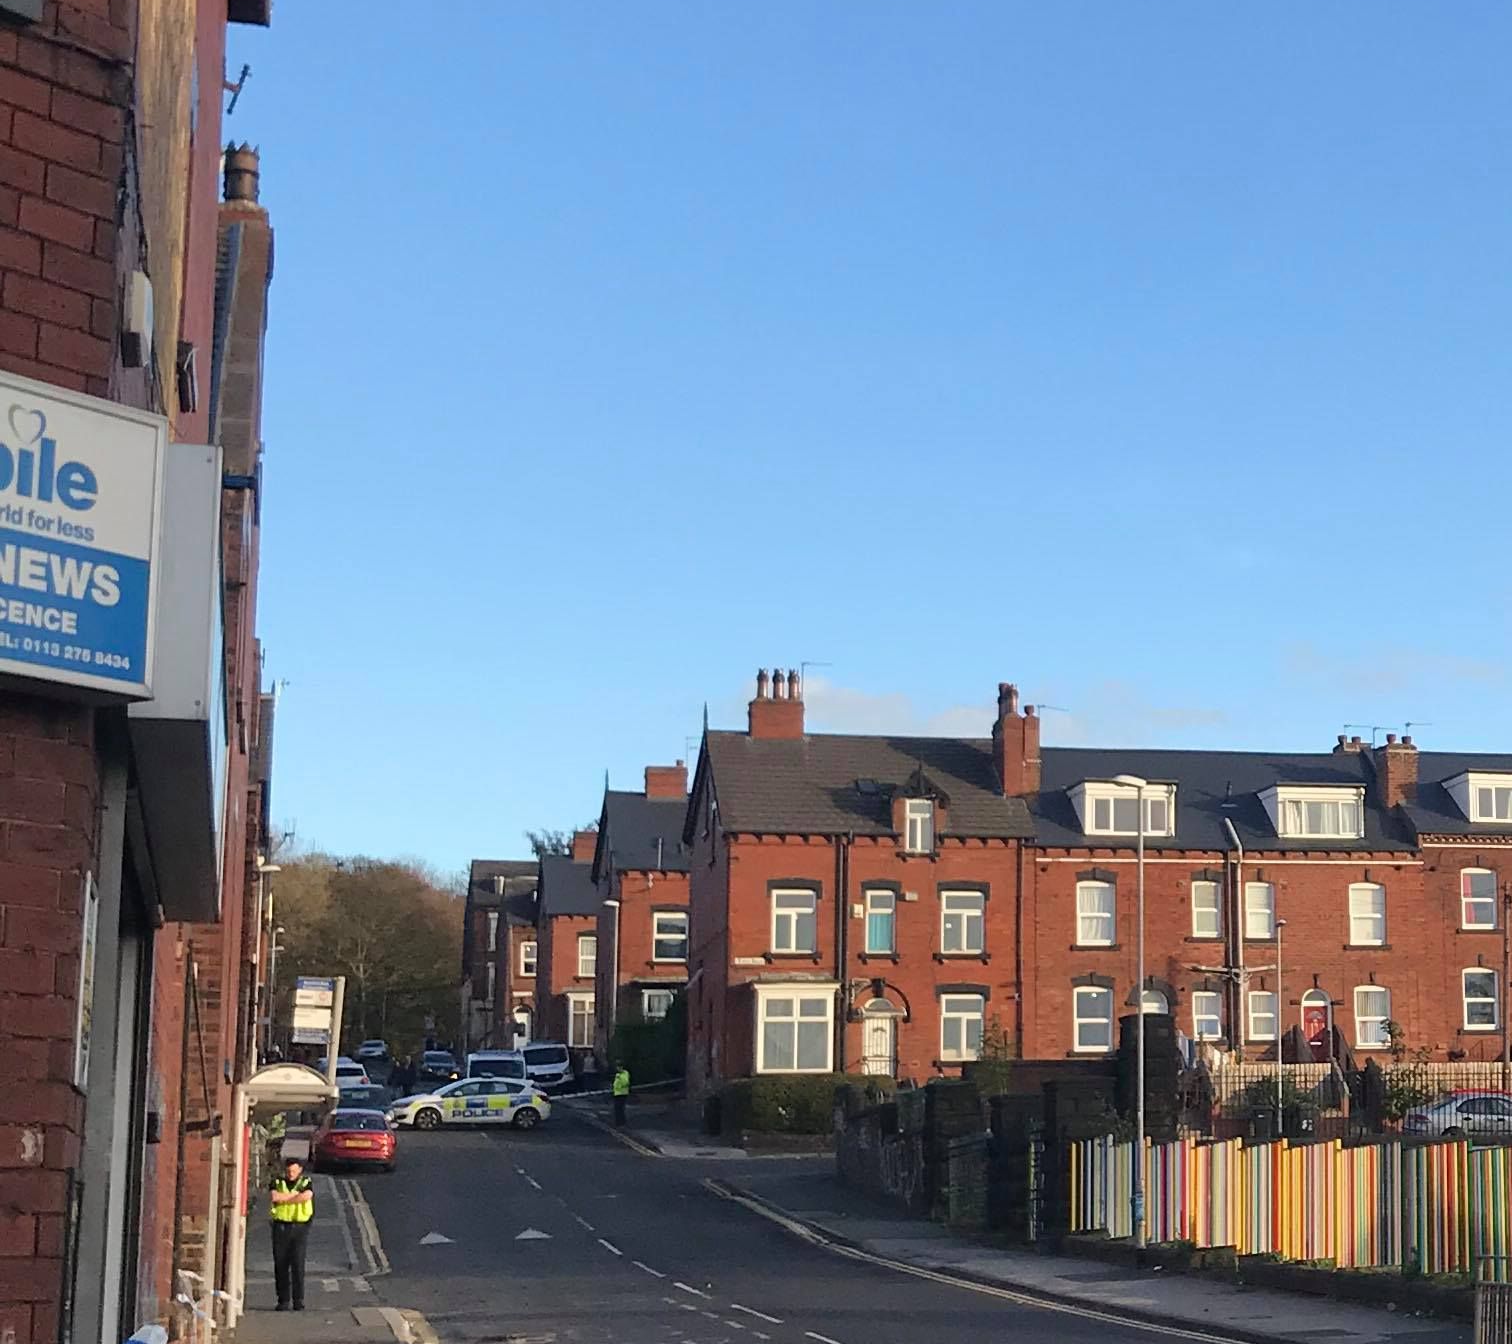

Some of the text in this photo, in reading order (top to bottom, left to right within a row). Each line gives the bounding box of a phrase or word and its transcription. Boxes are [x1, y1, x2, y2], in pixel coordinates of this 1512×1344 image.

[27, 509, 55, 531] for
[57, 516, 95, 542] less
[24, 637, 60, 656] 0113
[453, 1109, 503, 1118] POLICE
